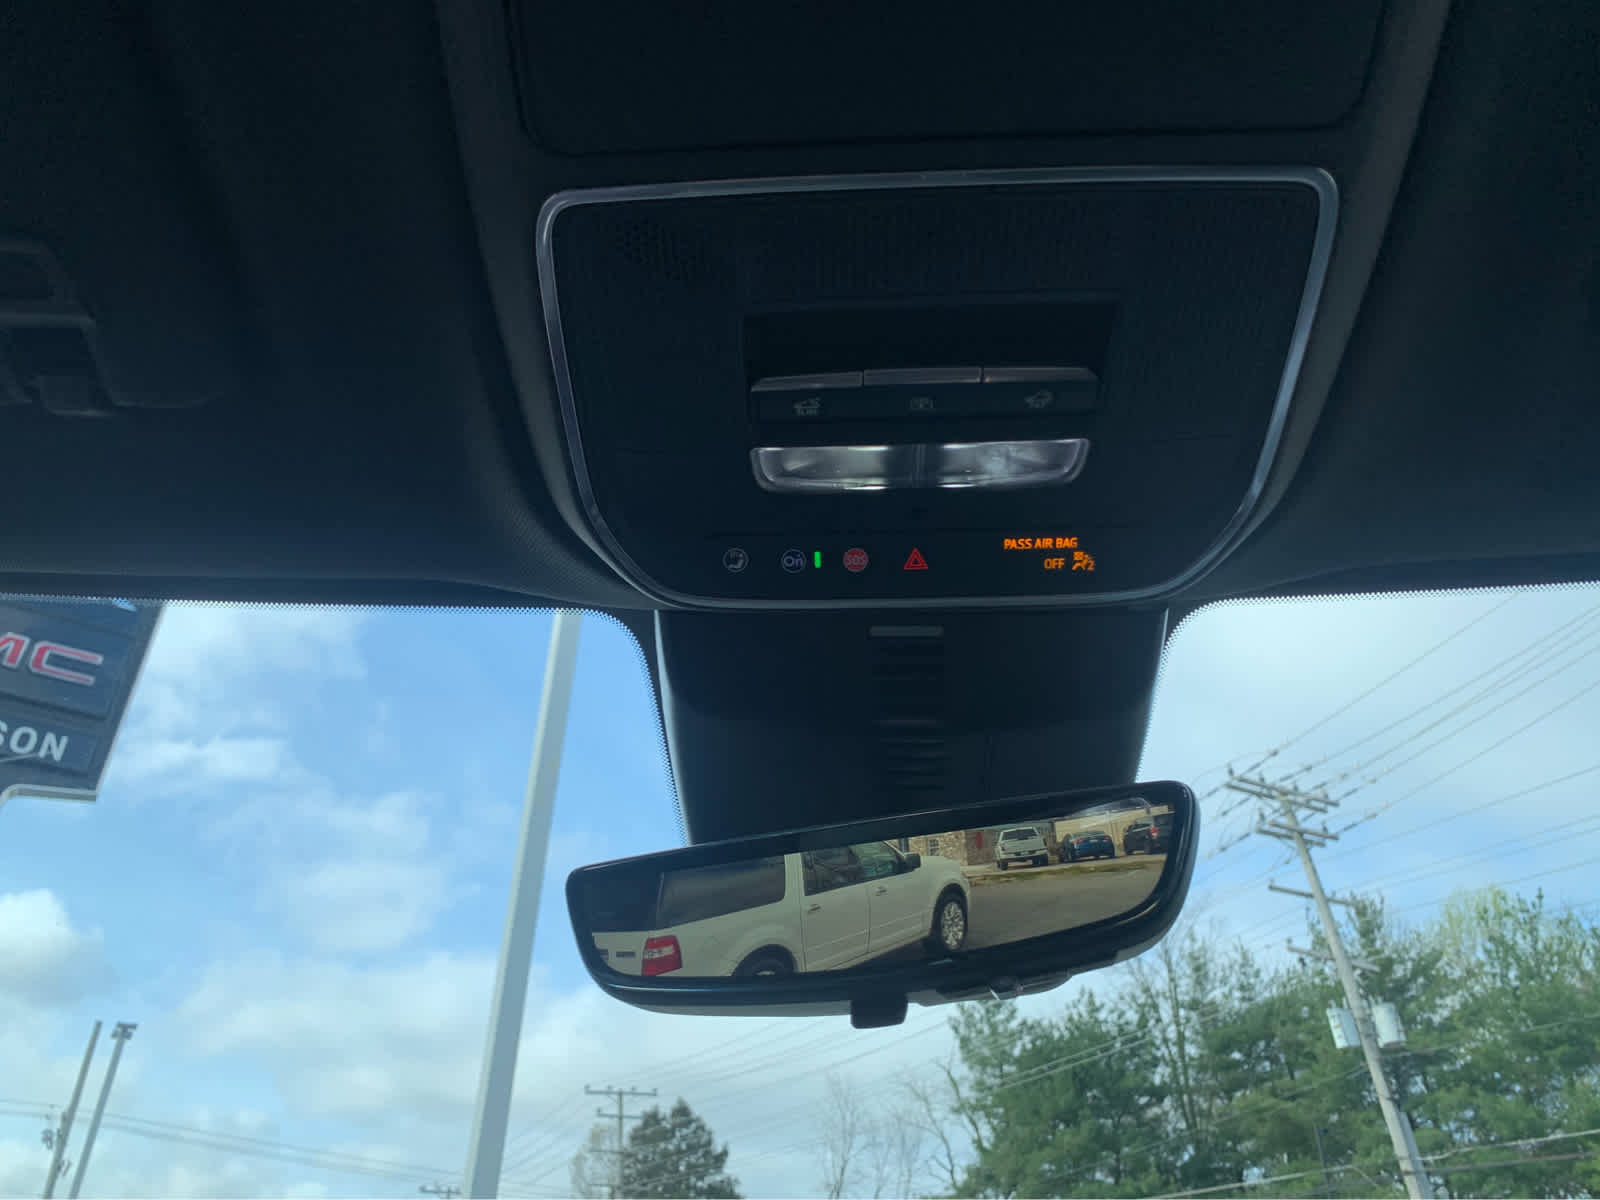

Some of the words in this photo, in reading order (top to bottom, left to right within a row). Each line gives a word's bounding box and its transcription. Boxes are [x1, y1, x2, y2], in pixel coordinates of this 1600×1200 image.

[1004, 538, 1032, 550] PASS
[1034, 537, 1053, 549] AIR
[1055, 536, 1078, 549] BAG
[784, 556, 804, 567] On
[846, 554, 866, 565] SOS
[1044, 558, 1065, 569] OFF
